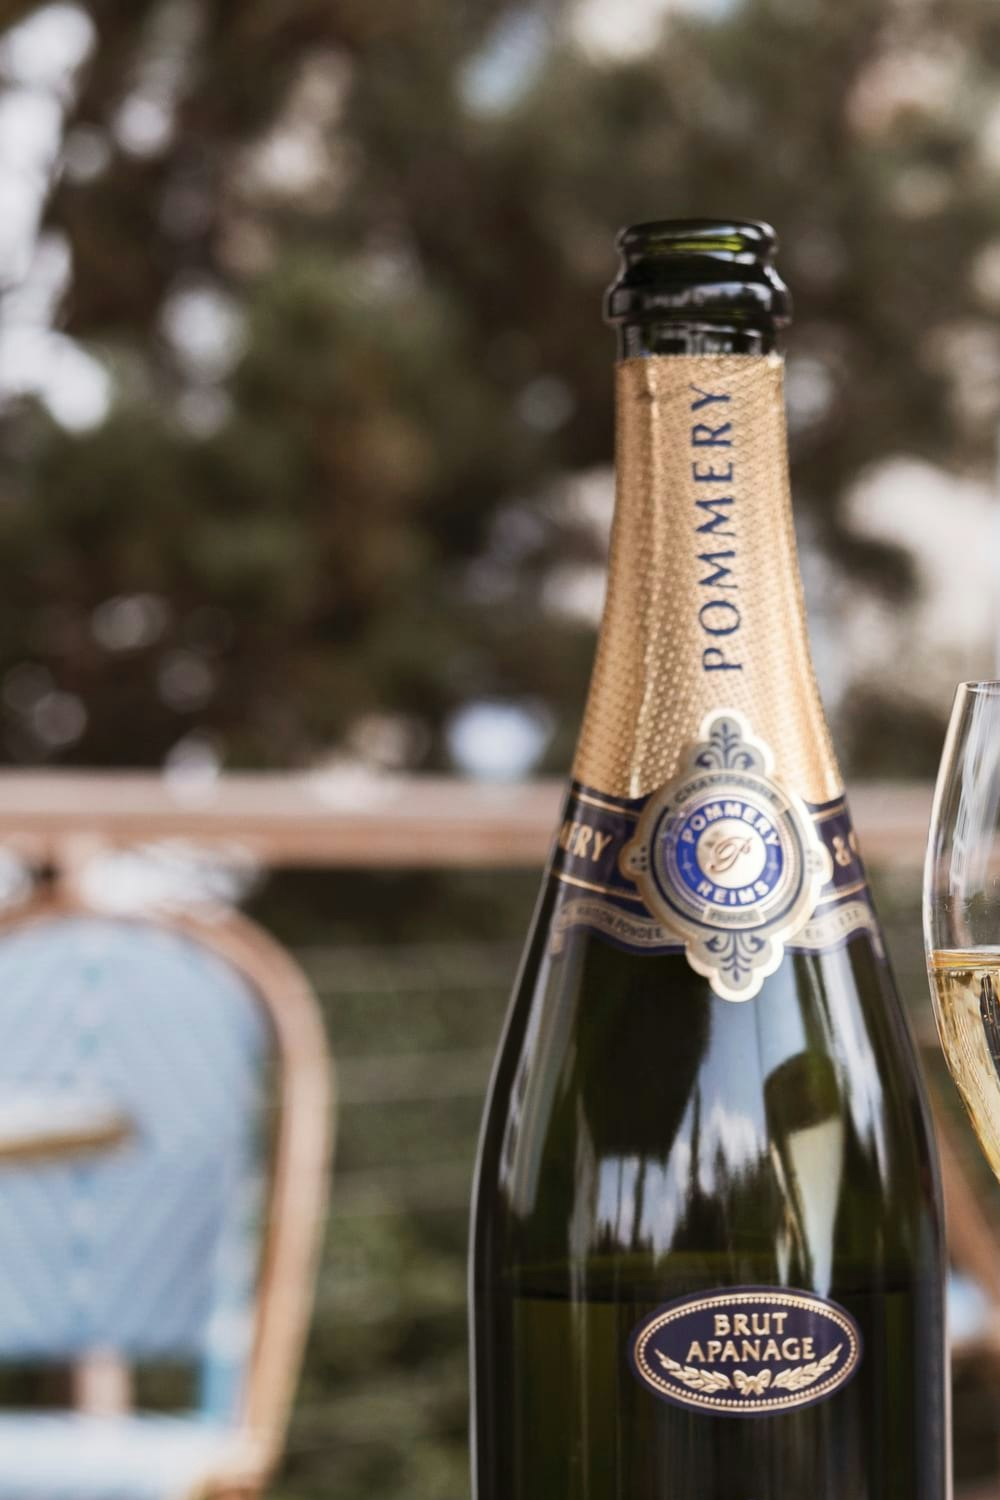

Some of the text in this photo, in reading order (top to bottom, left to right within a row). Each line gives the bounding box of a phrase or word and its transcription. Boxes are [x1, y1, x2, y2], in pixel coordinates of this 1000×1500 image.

[689, 381, 744, 673] POMMERY
[681, 801, 780, 846] POMMERY
[696, 880, 769, 905] REIMS
[714, 1312, 788, 1336] BRUT
[686, 1337, 816, 1363] APANAGE
